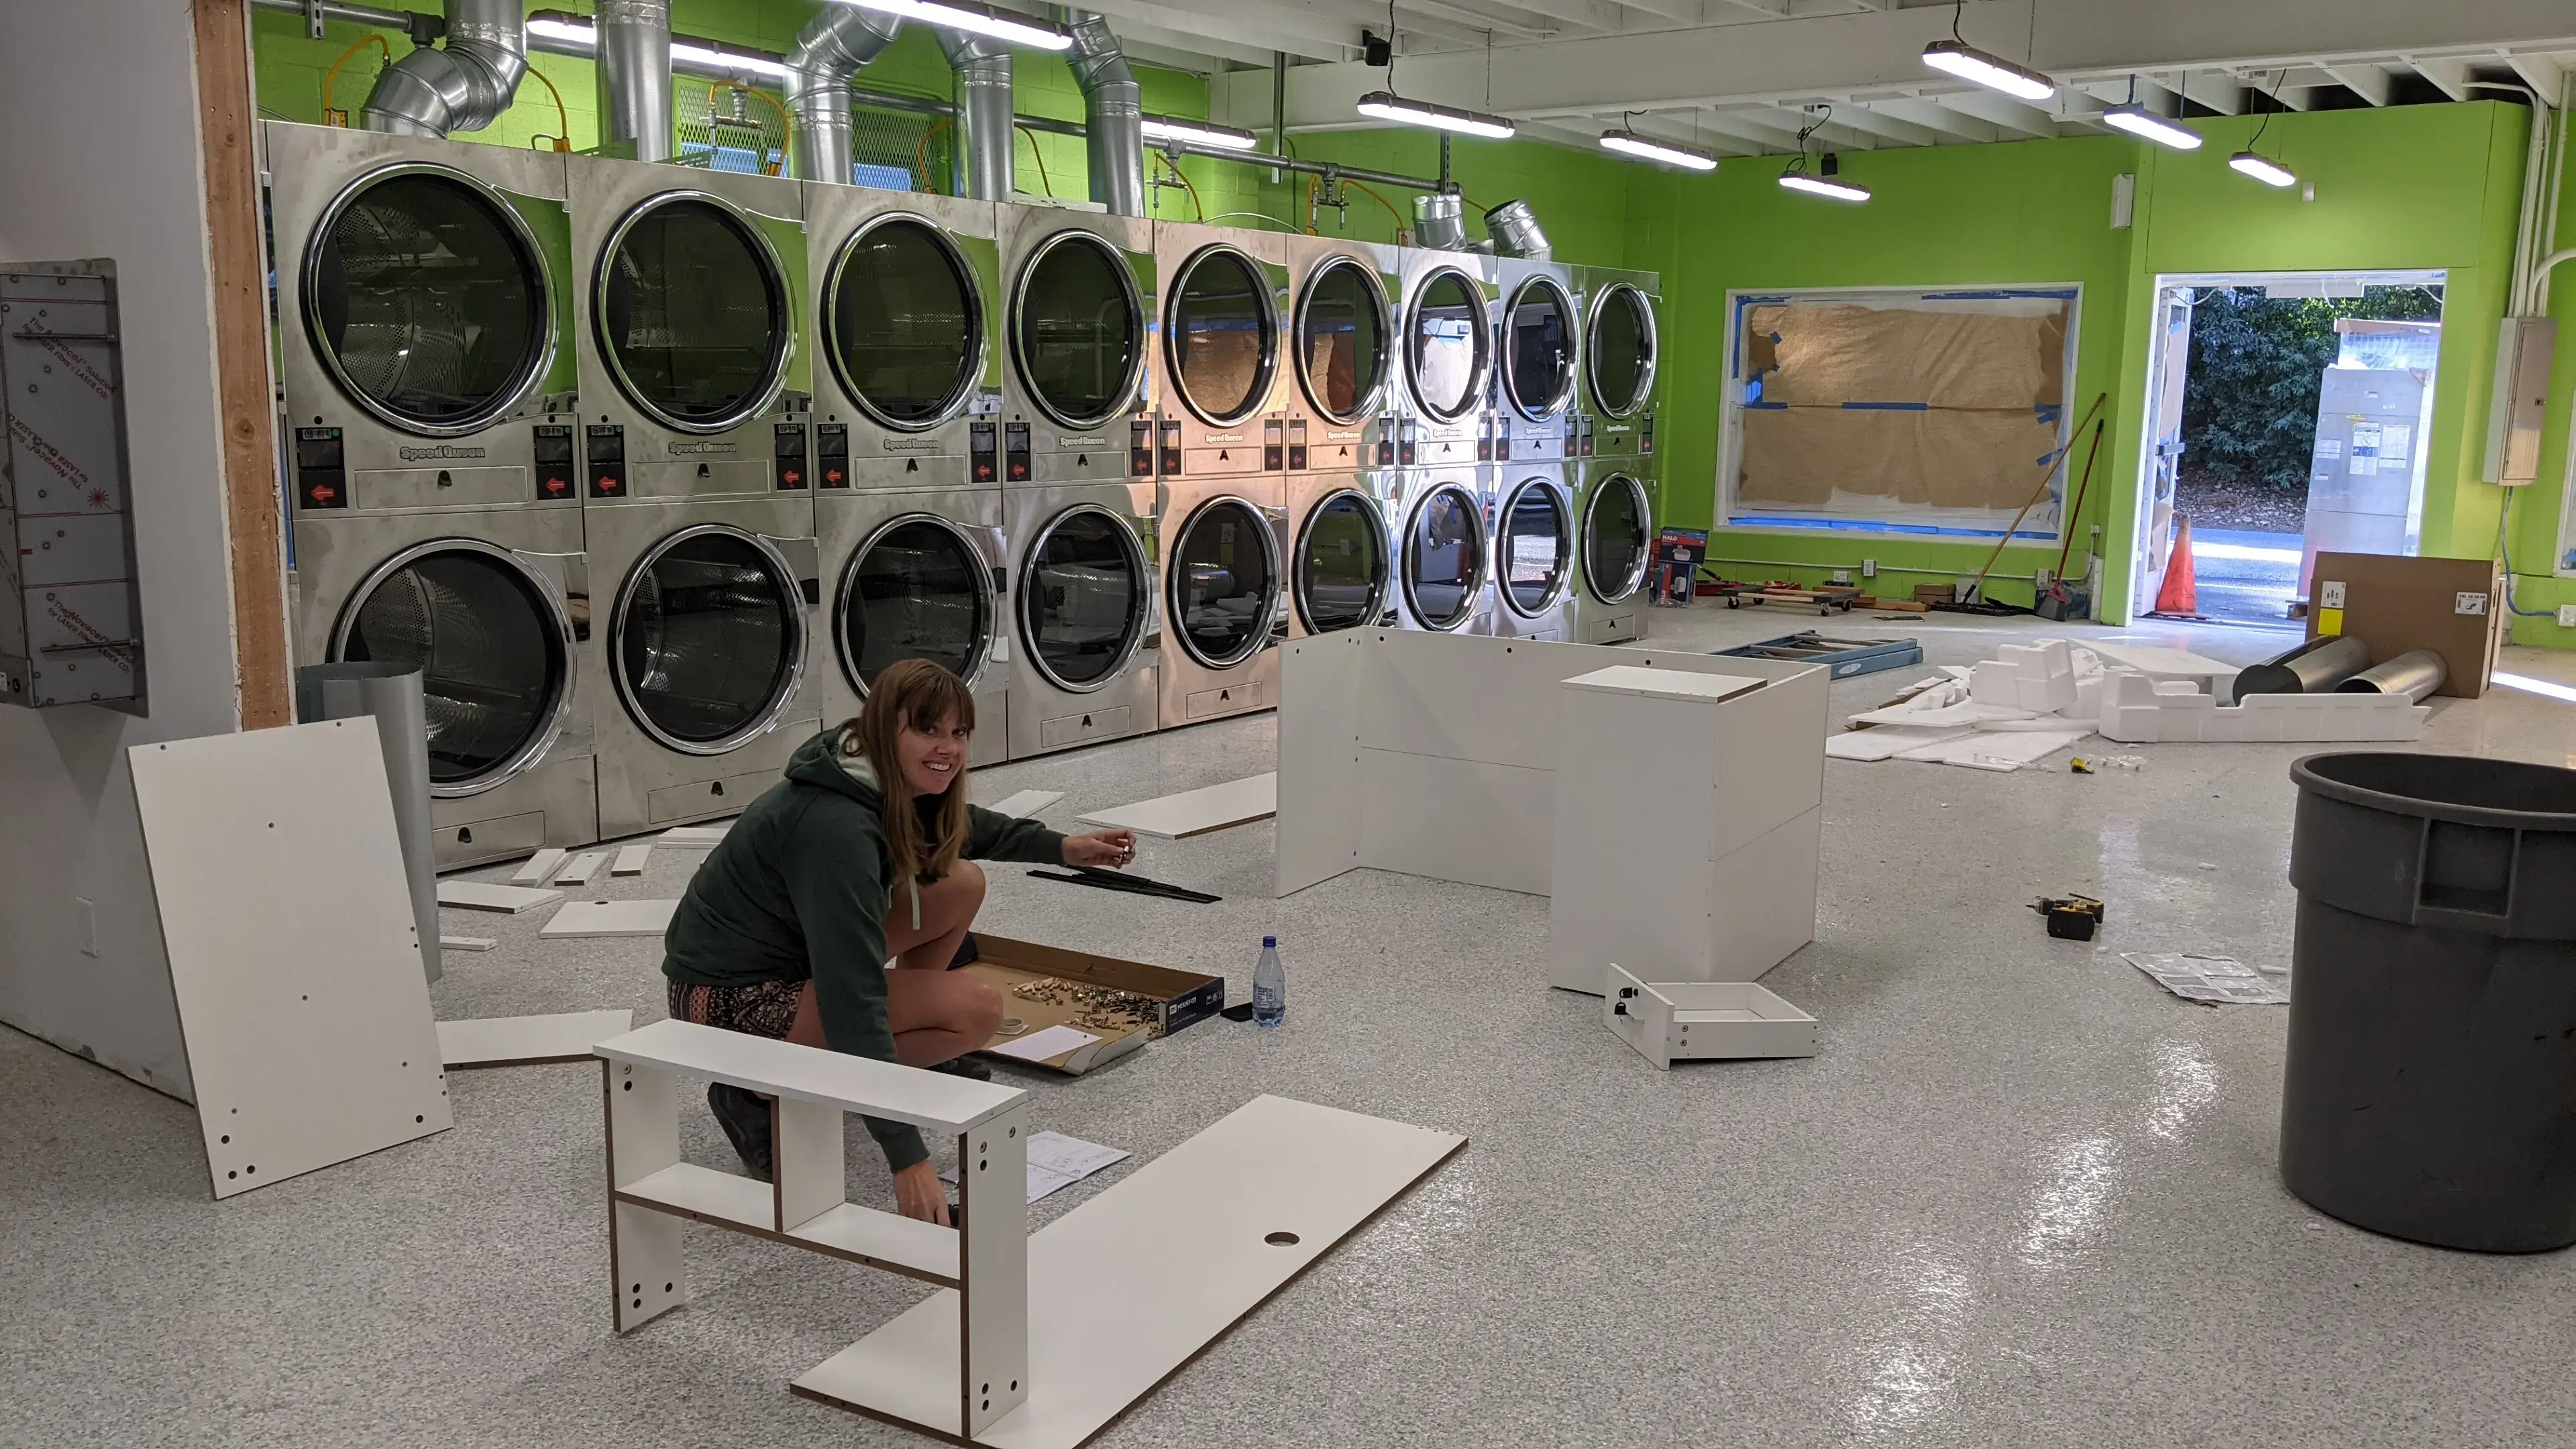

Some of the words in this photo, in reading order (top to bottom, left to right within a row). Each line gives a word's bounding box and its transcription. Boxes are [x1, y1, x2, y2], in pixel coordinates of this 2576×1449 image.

[75, 369, 97, 389] LASER
[883, 439, 912, 451] Speed
[912, 438, 938, 449] Queen
[1060, 436, 1083, 447] Speed
[1082, 435, 1106, 445] Queen
[1205, 433, 1225, 444] Speed
[1224, 433, 1243, 442] Queen
[400, 446, 443, 462] Speed
[443, 445, 485, 459] Queen
[668, 442, 703, 455] Speed
[702, 441, 737, 453] Queen
